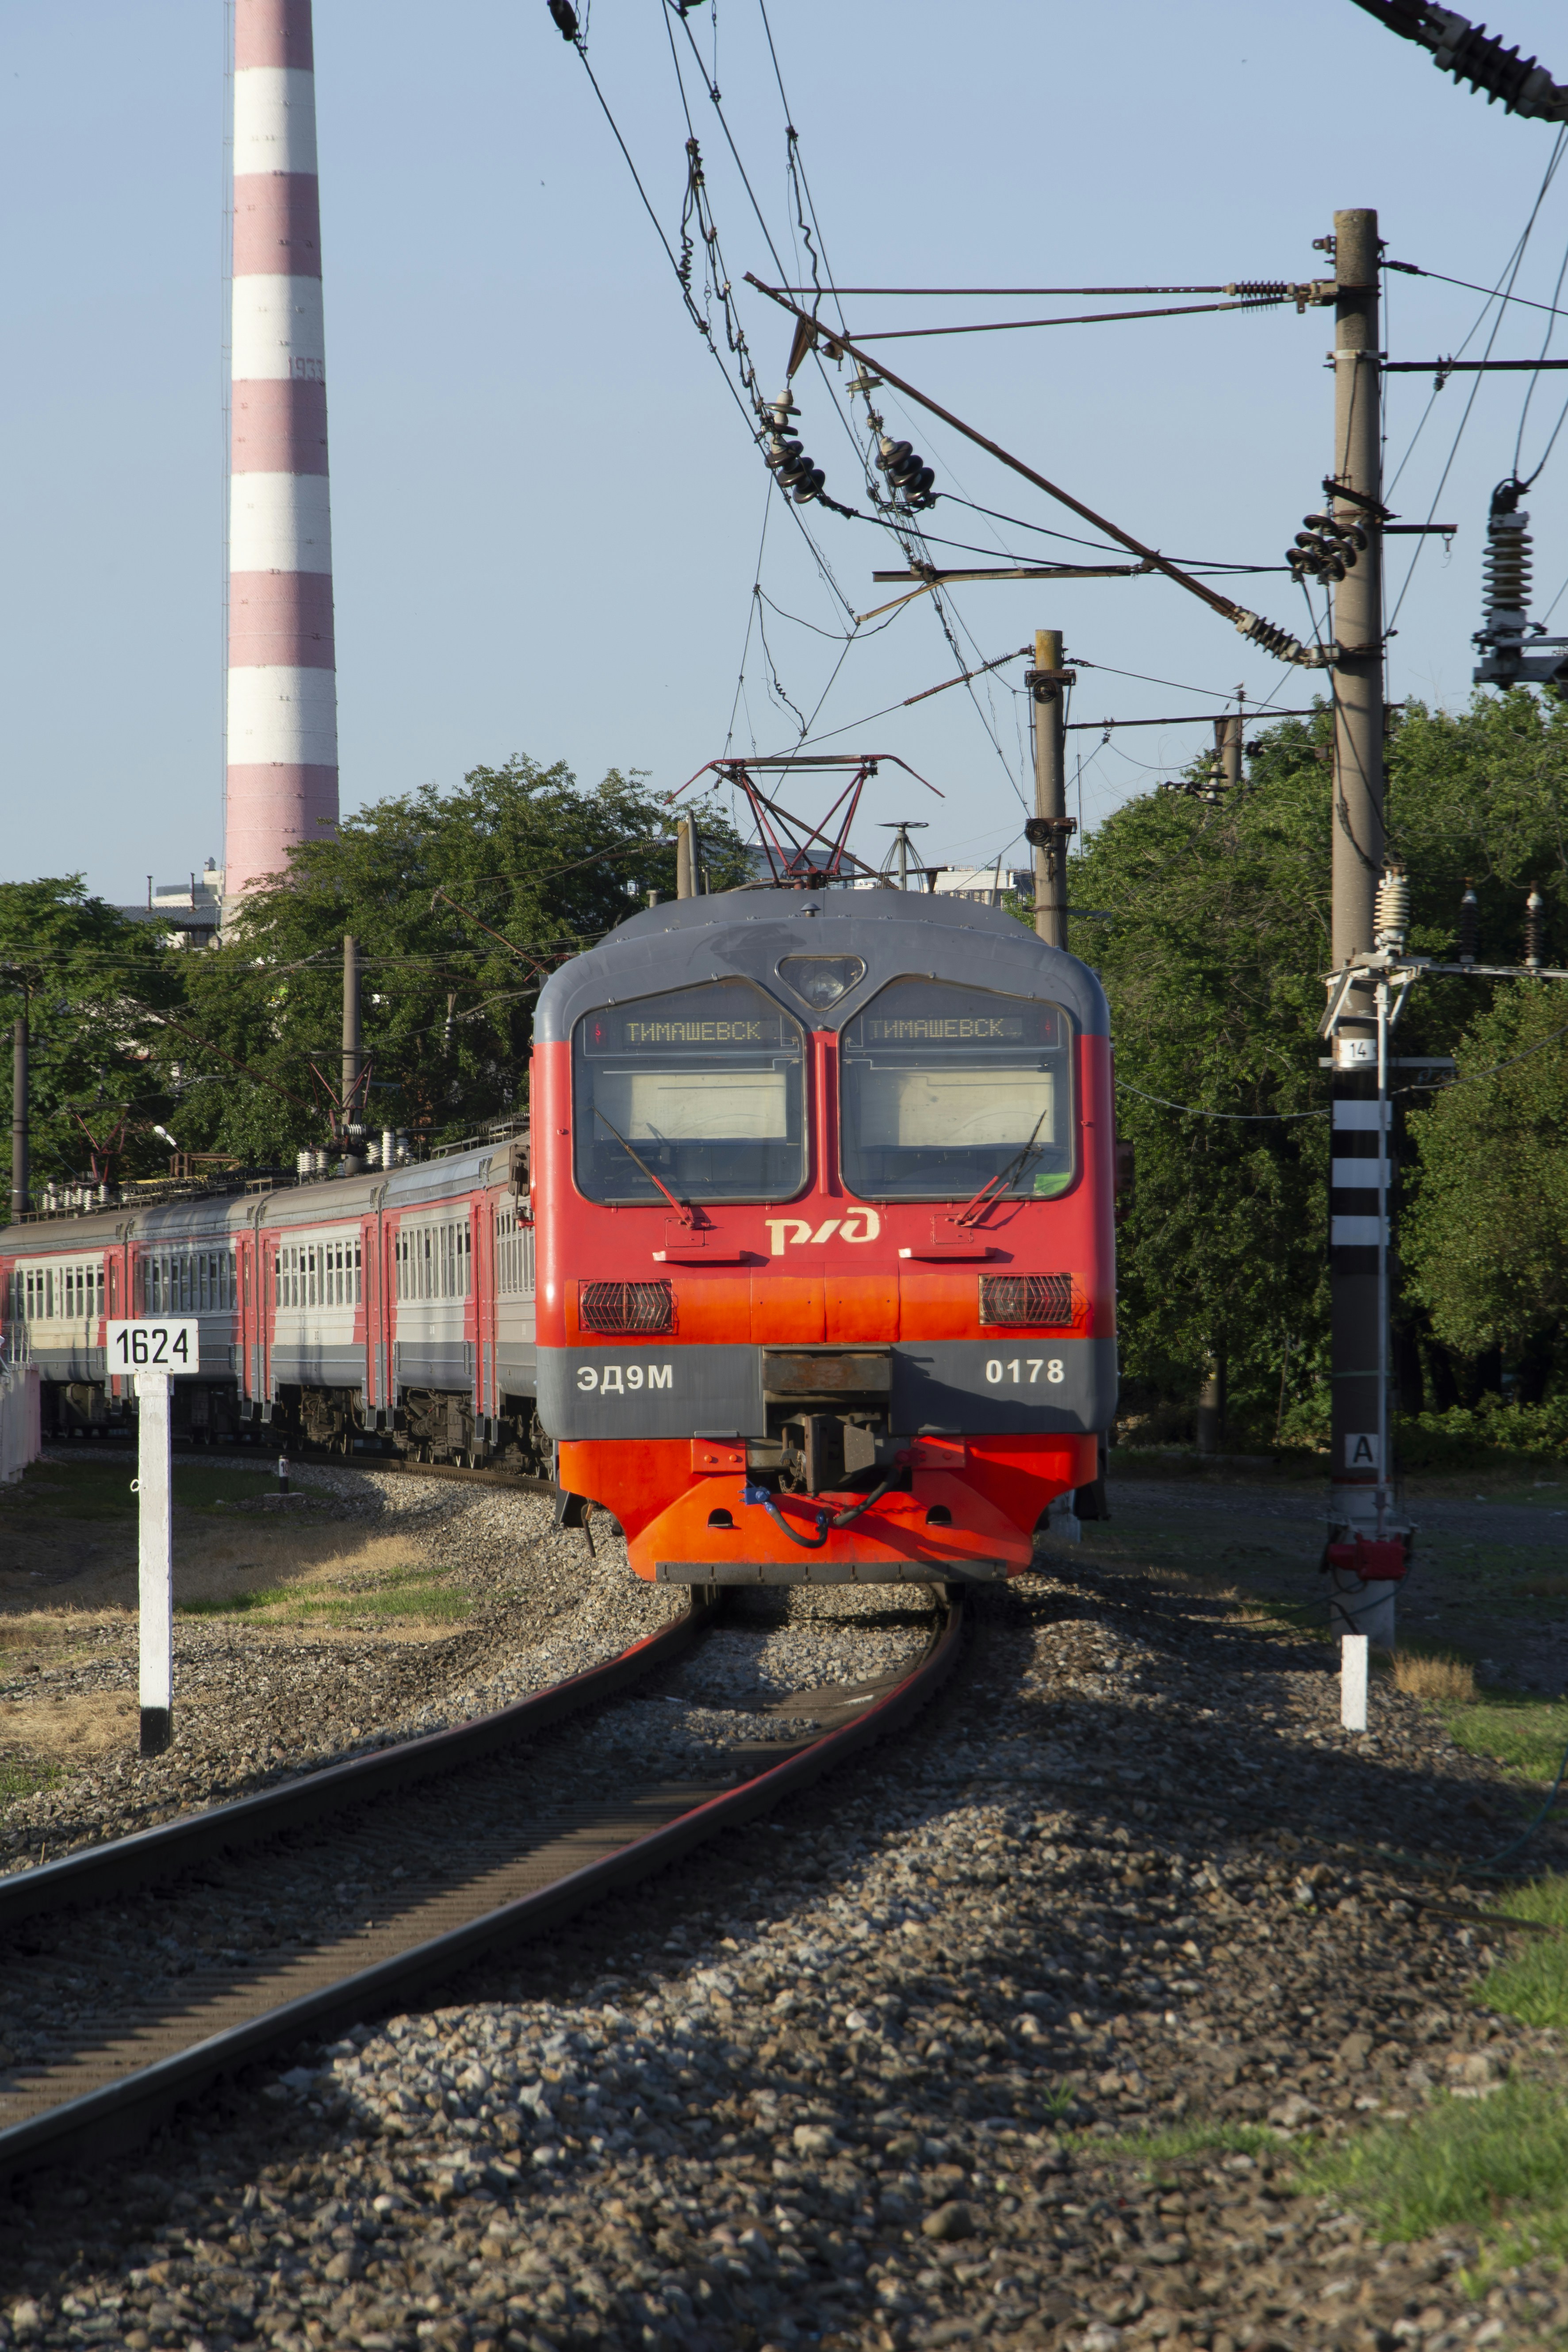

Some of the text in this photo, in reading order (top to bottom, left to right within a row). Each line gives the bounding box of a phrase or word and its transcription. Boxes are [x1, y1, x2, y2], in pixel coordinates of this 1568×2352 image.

[626, 1022, 760, 1041] ТИМАШЕВСК
[869, 1018, 1004, 1038] ТИМАШЕВСК
[1349, 1042, 1367, 1057] 14
[117, 1329, 188, 1364] 1624
[577, 1365, 673, 1394] ЭД9М
[985, 1359, 1065, 1383] 0178
